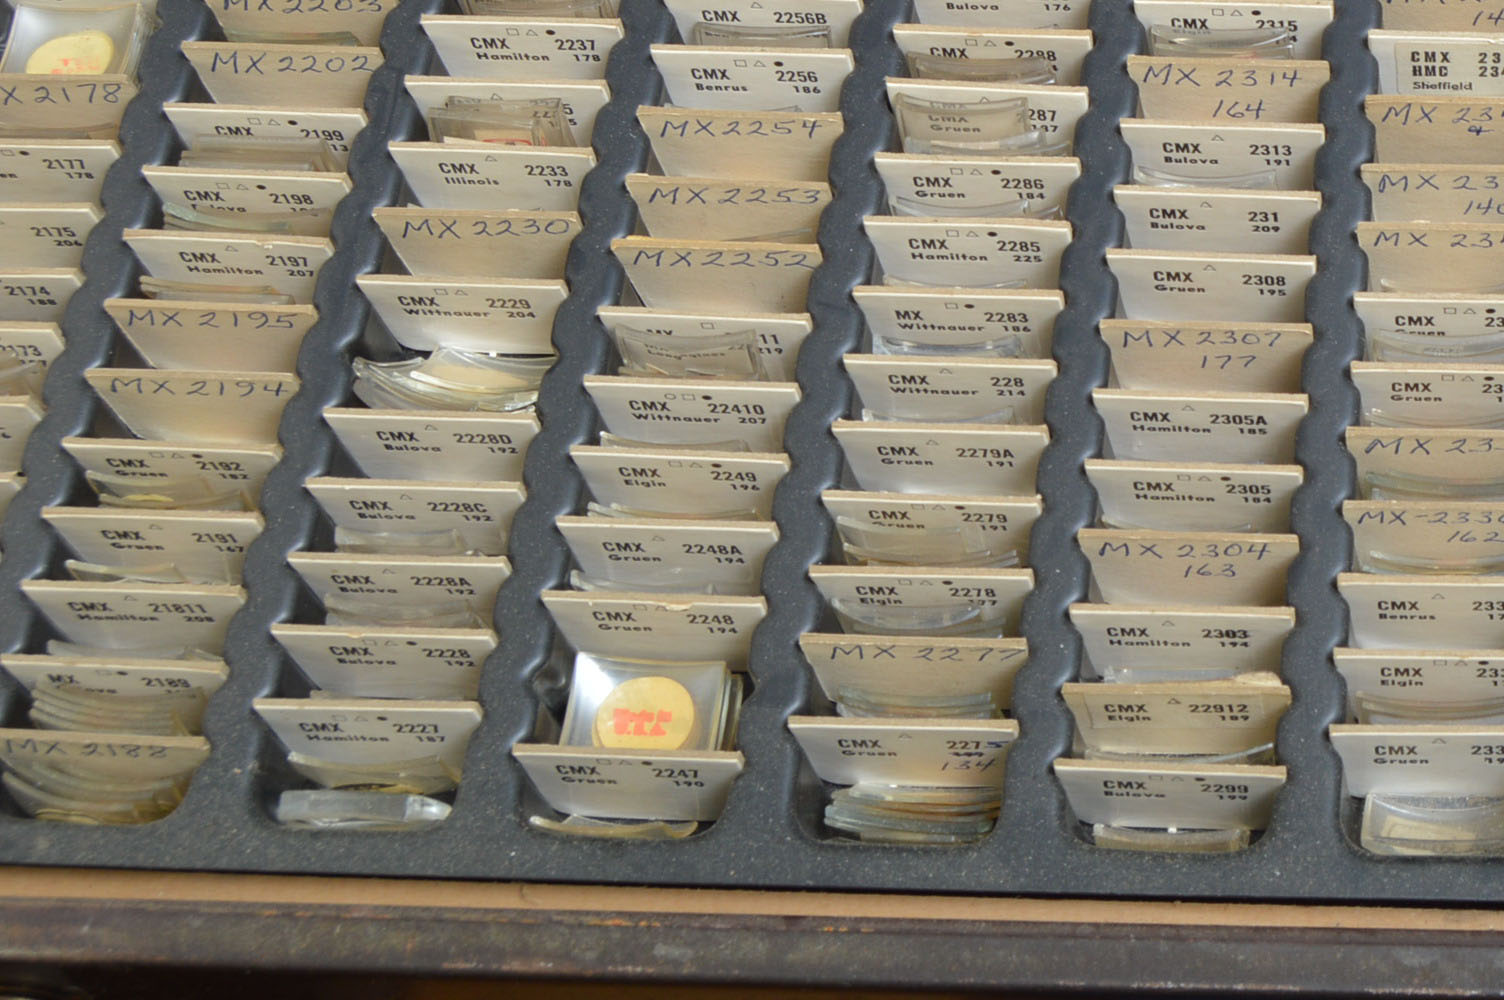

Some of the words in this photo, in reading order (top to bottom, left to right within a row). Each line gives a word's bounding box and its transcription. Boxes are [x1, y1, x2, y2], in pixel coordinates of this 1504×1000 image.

[945, 2, 1000, 11] Bulova
[1044, 3, 1072, 12] 176
[469, 37, 511, 50] CMX
[554, 38, 596, 52] 2237
[475, 51, 550, 62] Hamilton
[573, 53, 602, 63] 178
[1410, 50, 1451, 64] CMX
[690, 67, 731, 81] CMX
[775, 70, 819, 83] 2256
[1411, 64, 1449, 78] HMC
[694, 82, 748, 92] Benrus
[793, 85, 822, 95] 186
[1412, 80, 1473, 91] Sheffield
[659, 118, 716, 139] MX
[722, 119, 823, 140] 2254
[126, 309, 183, 329] MX
[198, 311, 299, 330] 2195
[1122, 329, 1185, 349] MX
[1195, 329, 1282, 348] 2307
[1200, 354, 1257, 370] 177
[628, 399, 671, 412] CMX
[707, 403, 766, 416] 22410
[631, 412, 721, 423] Wittnauer
[738, 416, 767, 425] 207
[348, 499, 393, 511] CMX
[426, 501, 488, 514] 2228C
[1097, 541, 1163, 560] MX
[1177, 542, 1272, 561] 2304
[1183, 562, 1237, 579] 163
[1377, 600, 1419, 611] CMX
